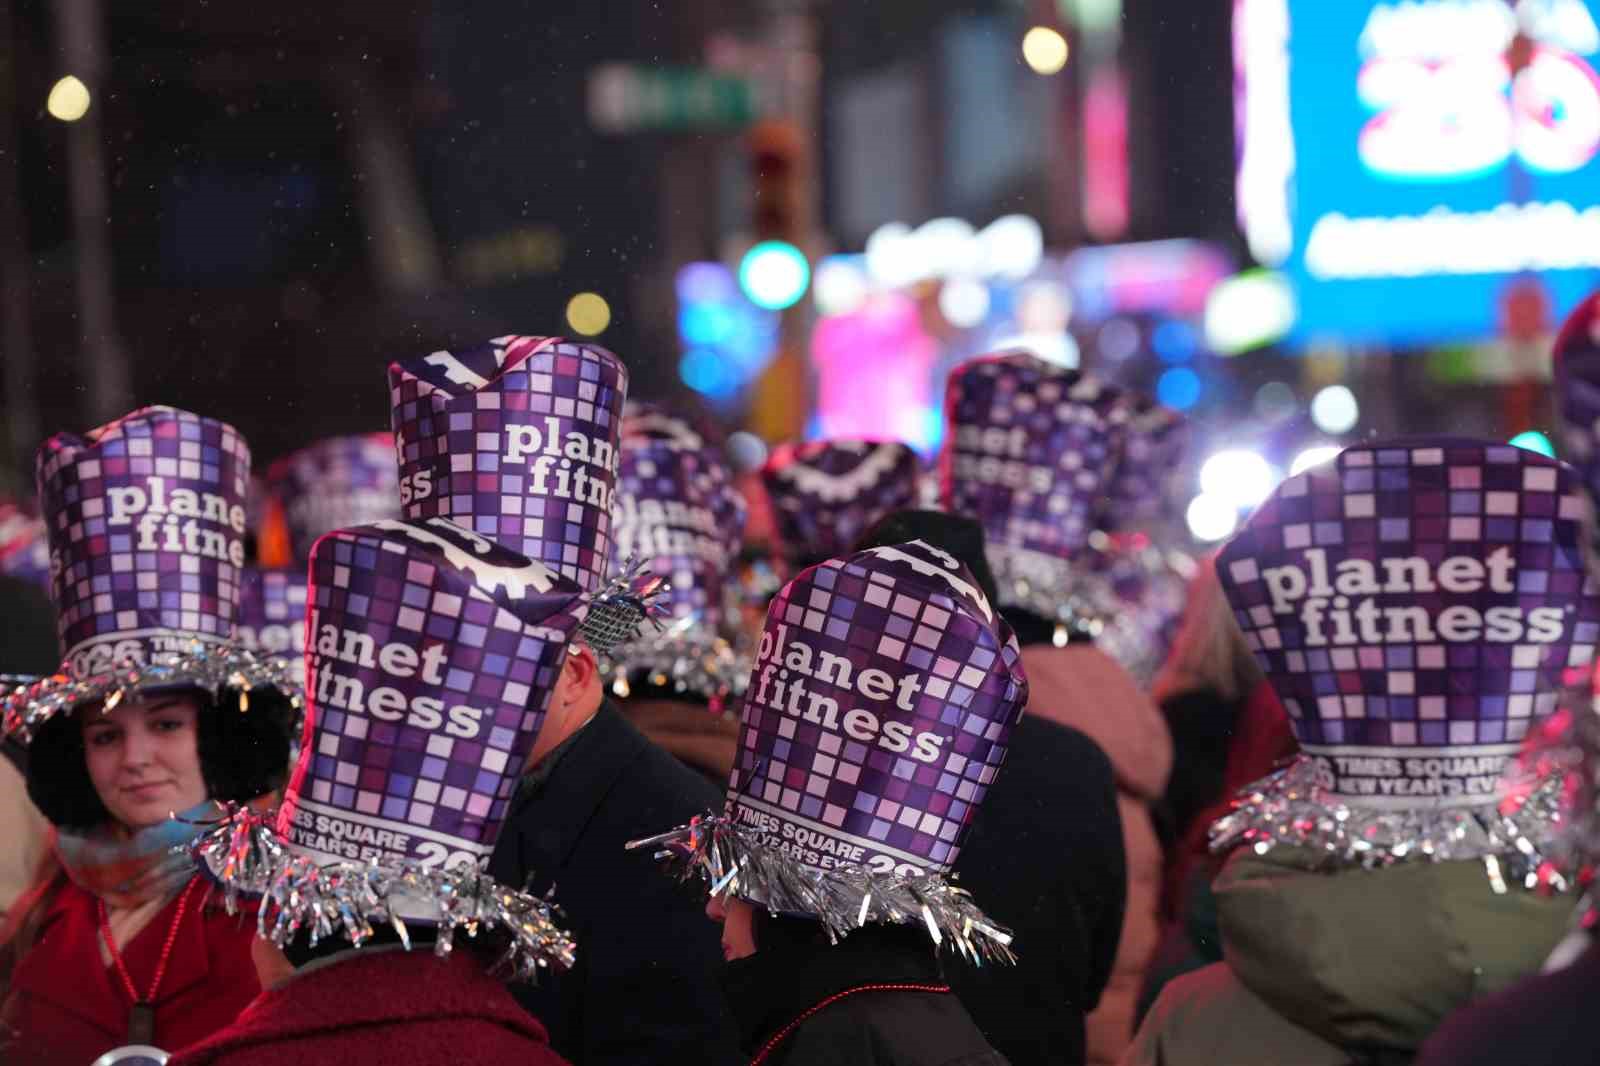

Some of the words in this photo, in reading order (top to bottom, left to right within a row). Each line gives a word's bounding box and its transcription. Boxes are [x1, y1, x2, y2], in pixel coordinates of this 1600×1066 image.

[502, 416, 619, 478] plane
[106, 476, 246, 534] plane
[528, 456, 616, 517] fitne
[135, 513, 245, 569] fitne
[1262, 546, 1517, 615] planet
[307, 608, 449, 686] lanet
[1299, 597, 1565, 647] fitness
[308, 655, 483, 739] itness
[752, 623, 922, 712] planet
[754, 663, 945, 763] fitness
[1334, 757, 1403, 777] TIMES
[315, 814, 412, 851] SQUARE
[736, 804, 779, 833] TIMES
[782, 822, 866, 862] SQUARE
